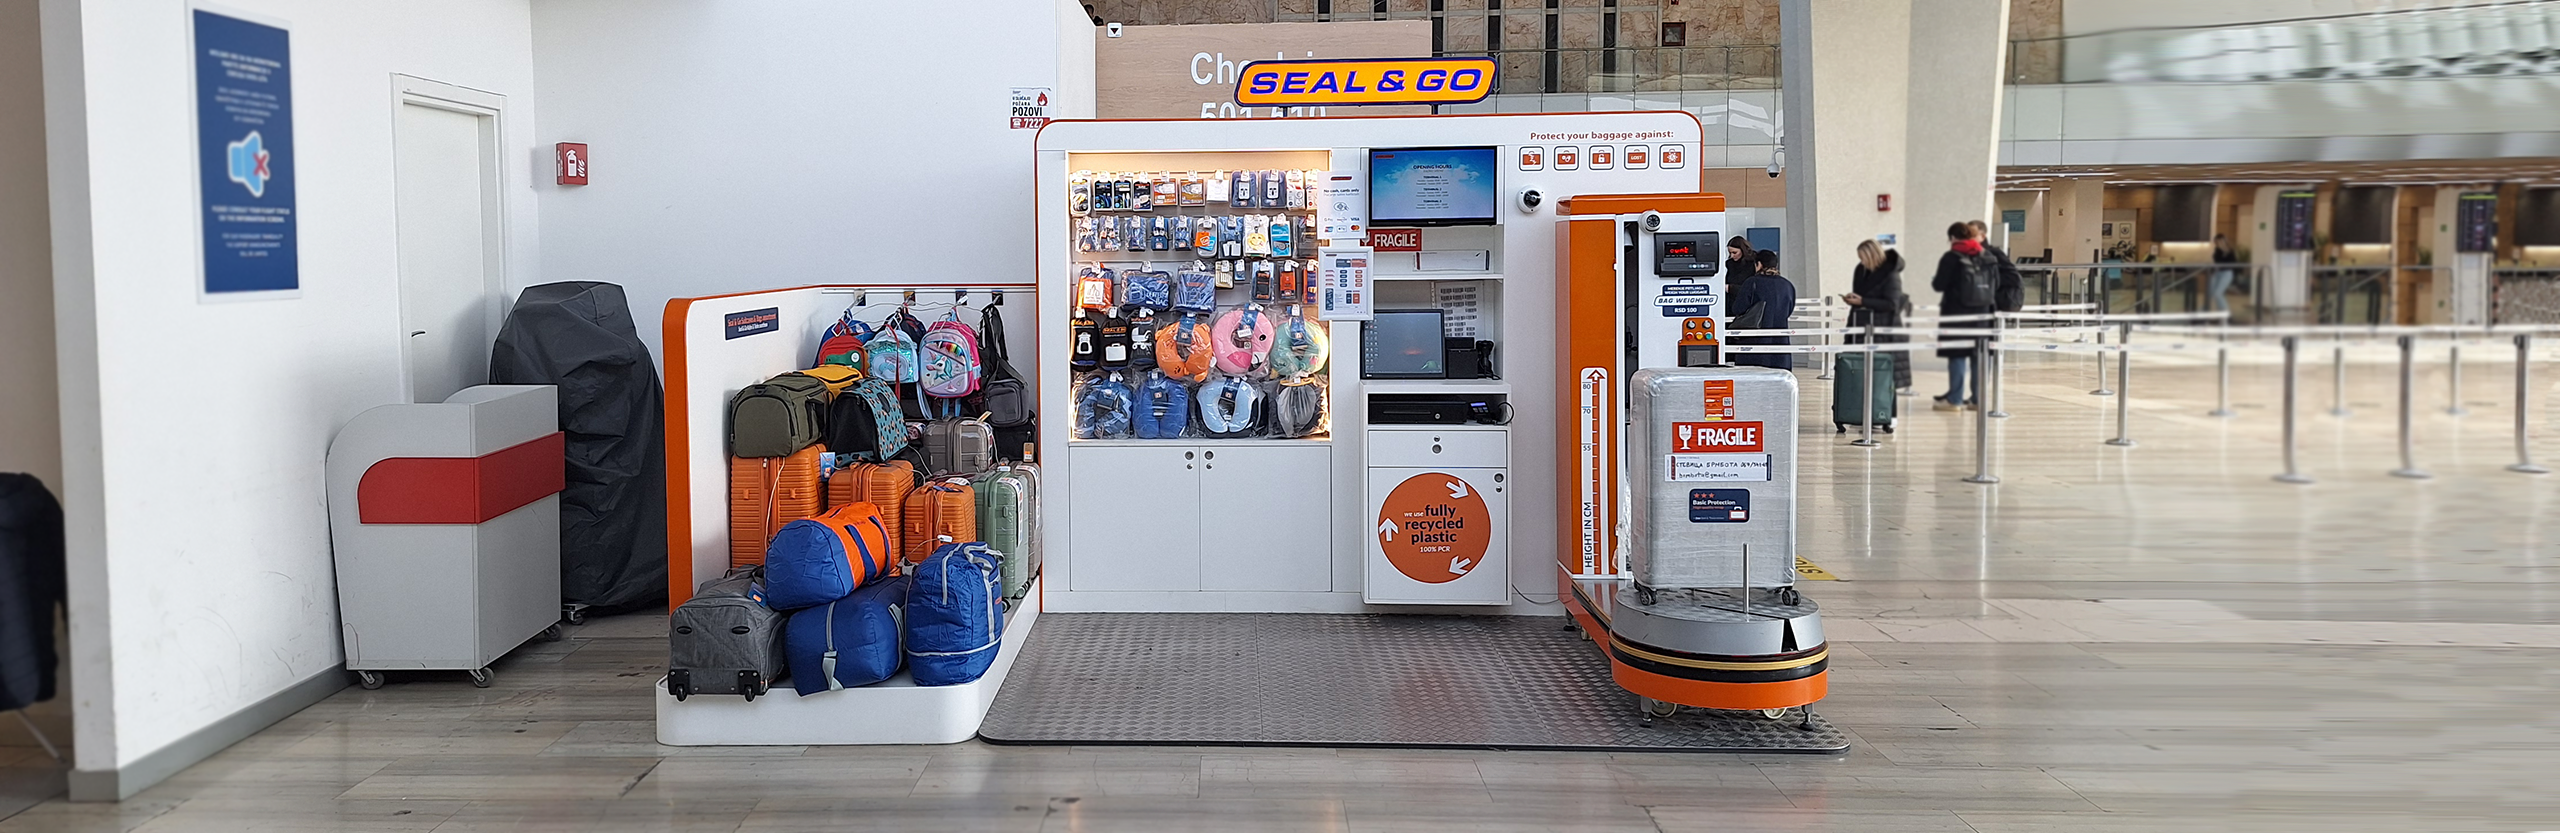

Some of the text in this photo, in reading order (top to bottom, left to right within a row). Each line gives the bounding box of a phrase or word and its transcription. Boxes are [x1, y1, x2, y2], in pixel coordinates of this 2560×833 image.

[1249, 68, 1483, 95] SEAL & GO
[1012, 106, 1043, 117] POZOVI
[1023, 118, 1044, 129] 7222
[1530, 130, 1674, 141] Protect your baggage against:
[1374, 233, 1417, 247] FRAGILE
[1697, 427, 1757, 446] FRAGILE
[1425, 504, 1457, 518] fully
[1405, 516, 1464, 532] recycled
[1411, 530, 1457, 546] plastic
[1583, 501, 1592, 568] HEIGHT IN CM
